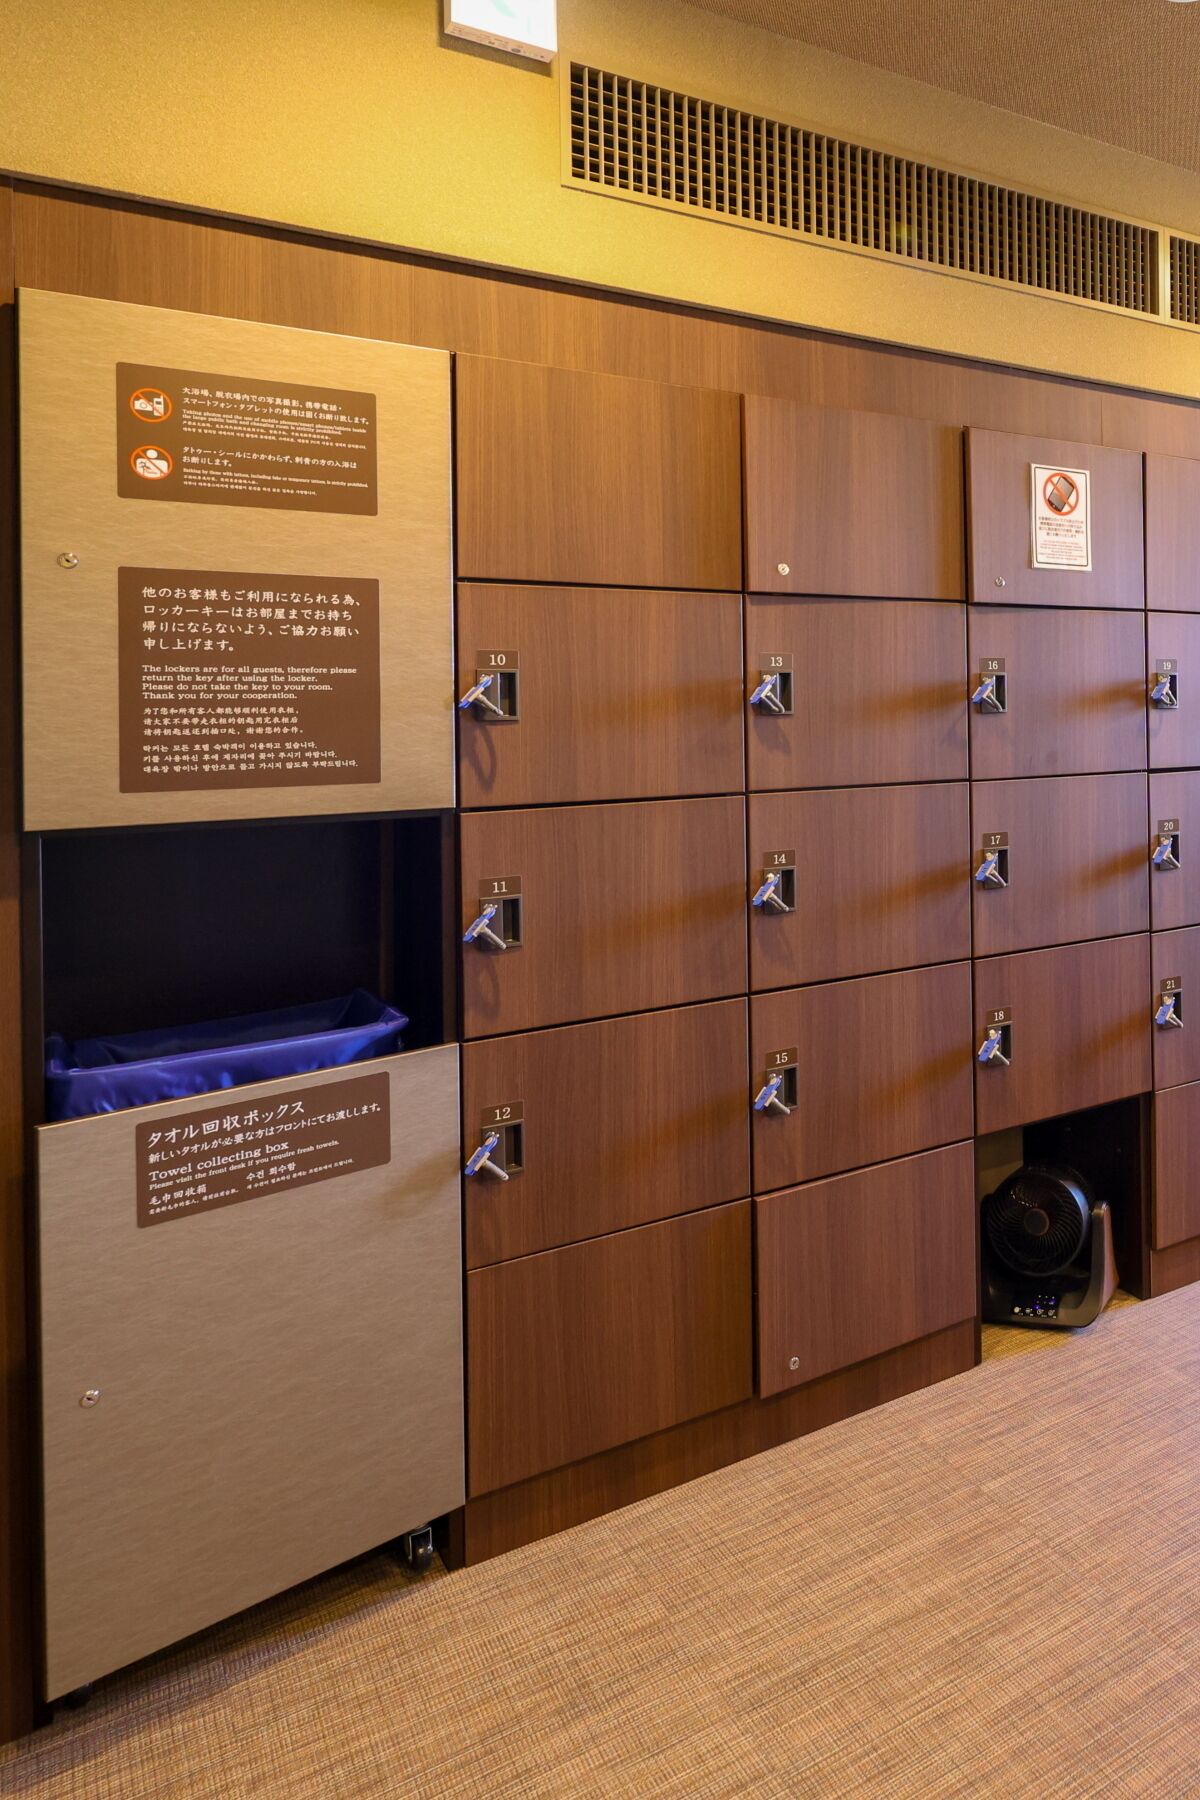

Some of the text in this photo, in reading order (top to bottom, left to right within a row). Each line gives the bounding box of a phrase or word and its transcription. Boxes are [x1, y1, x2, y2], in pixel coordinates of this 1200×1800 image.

[182, 456, 232, 467] お断りします。
[142, 587, 360, 605] 他のお客様もご利用になられる為、
[144, 605, 352, 621] ロッカーキーはお部屋までお持ち
[142, 621, 359, 636] 帰りにならないよう、ご協力お願い
[144, 638, 233, 651] 申し上げます。
[490, 654, 506, 666] 10
[770, 656, 783, 667] 13
[988, 660, 998, 670] 16
[1163, 662, 1171, 670] 19
[195, 674, 214, 682] key
[242, 674, 268, 682] using
[252, 683, 269, 691] key
[1164, 822, 1173, 830] 20
[991, 836, 1001, 845] 17
[773, 854, 786, 864] 14
[492, 882, 507, 894] 11
[1166, 980, 1175, 989] 21
[994, 1011, 1004, 1020] 18
[776, 1053, 788, 1064] 15
[494, 1107, 511, 1120] 12
[149, 1102, 304, 1147] タオル回収ボックス
[149, 1104, 380, 1163] 新しいタオルが必要な方はフロントにてお渡しします。
[149, 1142, 289, 1181] Towel collecting box
[149, 1180, 174, 1190] Please
[176, 1175, 192, 1184] visit
[208, 1167, 227, 1176] front
[229, 1162, 246, 1171] desk
[255, 1157, 269, 1165] you
[271, 1151, 295, 1161] require
[297, 1146, 314, 1154] fresh
[316, 1140, 339, 1150] towels.
